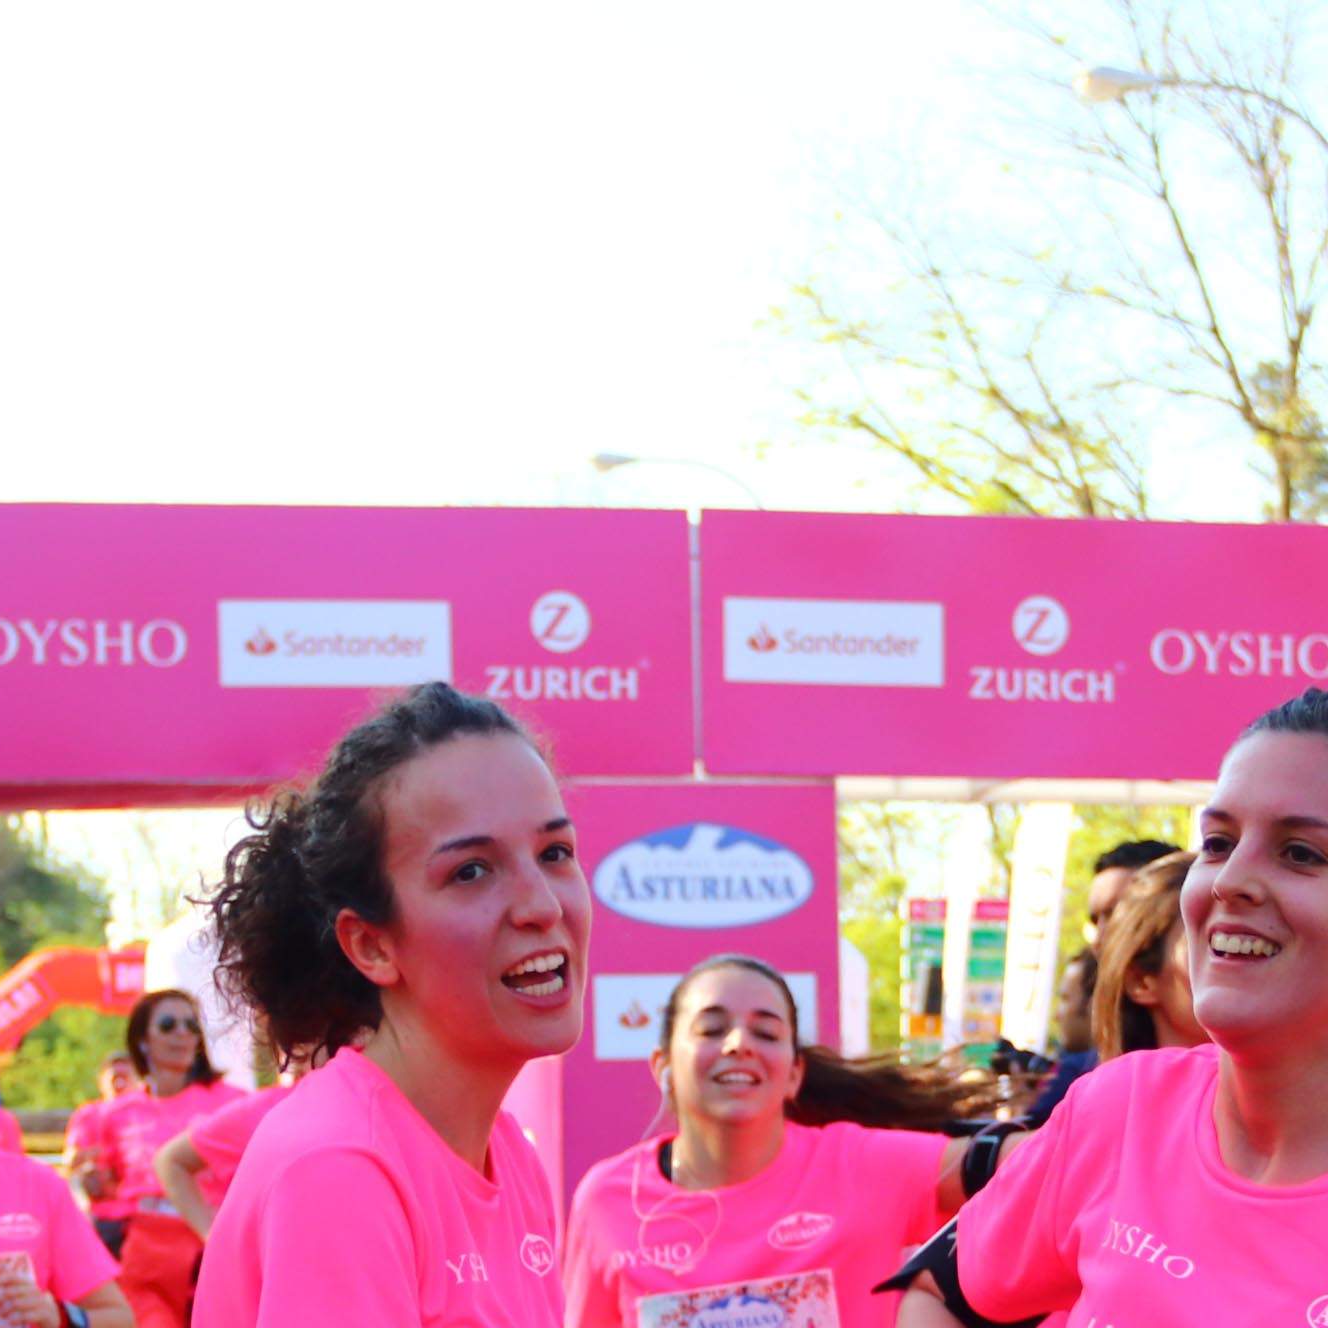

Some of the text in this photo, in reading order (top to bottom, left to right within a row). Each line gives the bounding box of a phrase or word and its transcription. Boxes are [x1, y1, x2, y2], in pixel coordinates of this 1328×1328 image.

[283, 629, 427, 659] Santander
[783, 629, 922, 659] Santander
[485, 666, 639, 701] ZURICH
[969, 668, 1115, 702] ZURICH
[612, 863, 796, 902] ASTURIANA
